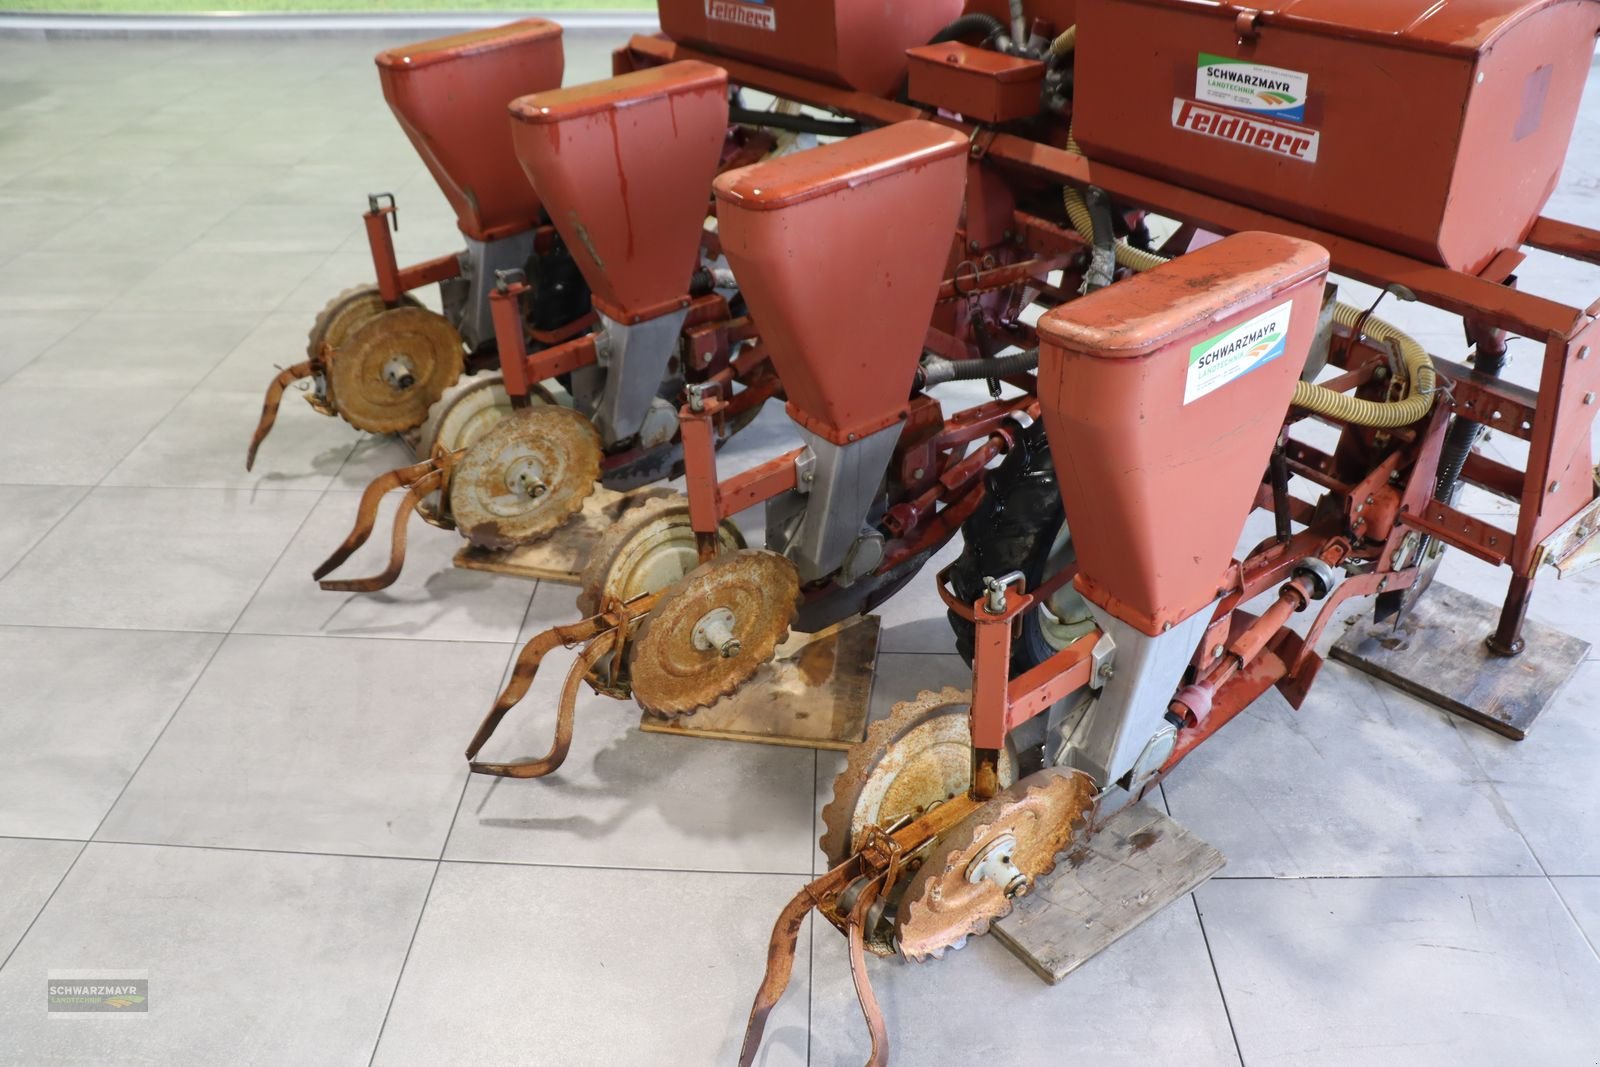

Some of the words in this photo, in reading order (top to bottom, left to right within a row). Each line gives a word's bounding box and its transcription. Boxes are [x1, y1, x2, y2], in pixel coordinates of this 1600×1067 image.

[1206, 67, 1290, 92] SCHWARZMAYR
[1207, 79, 1255, 95] LANDTECHNIK
[1176, 101, 1311, 158] Feldherr
[1198, 322, 1276, 369] SCHWARZMAYR
[1198, 350, 1244, 380] LANDTECHNIK
